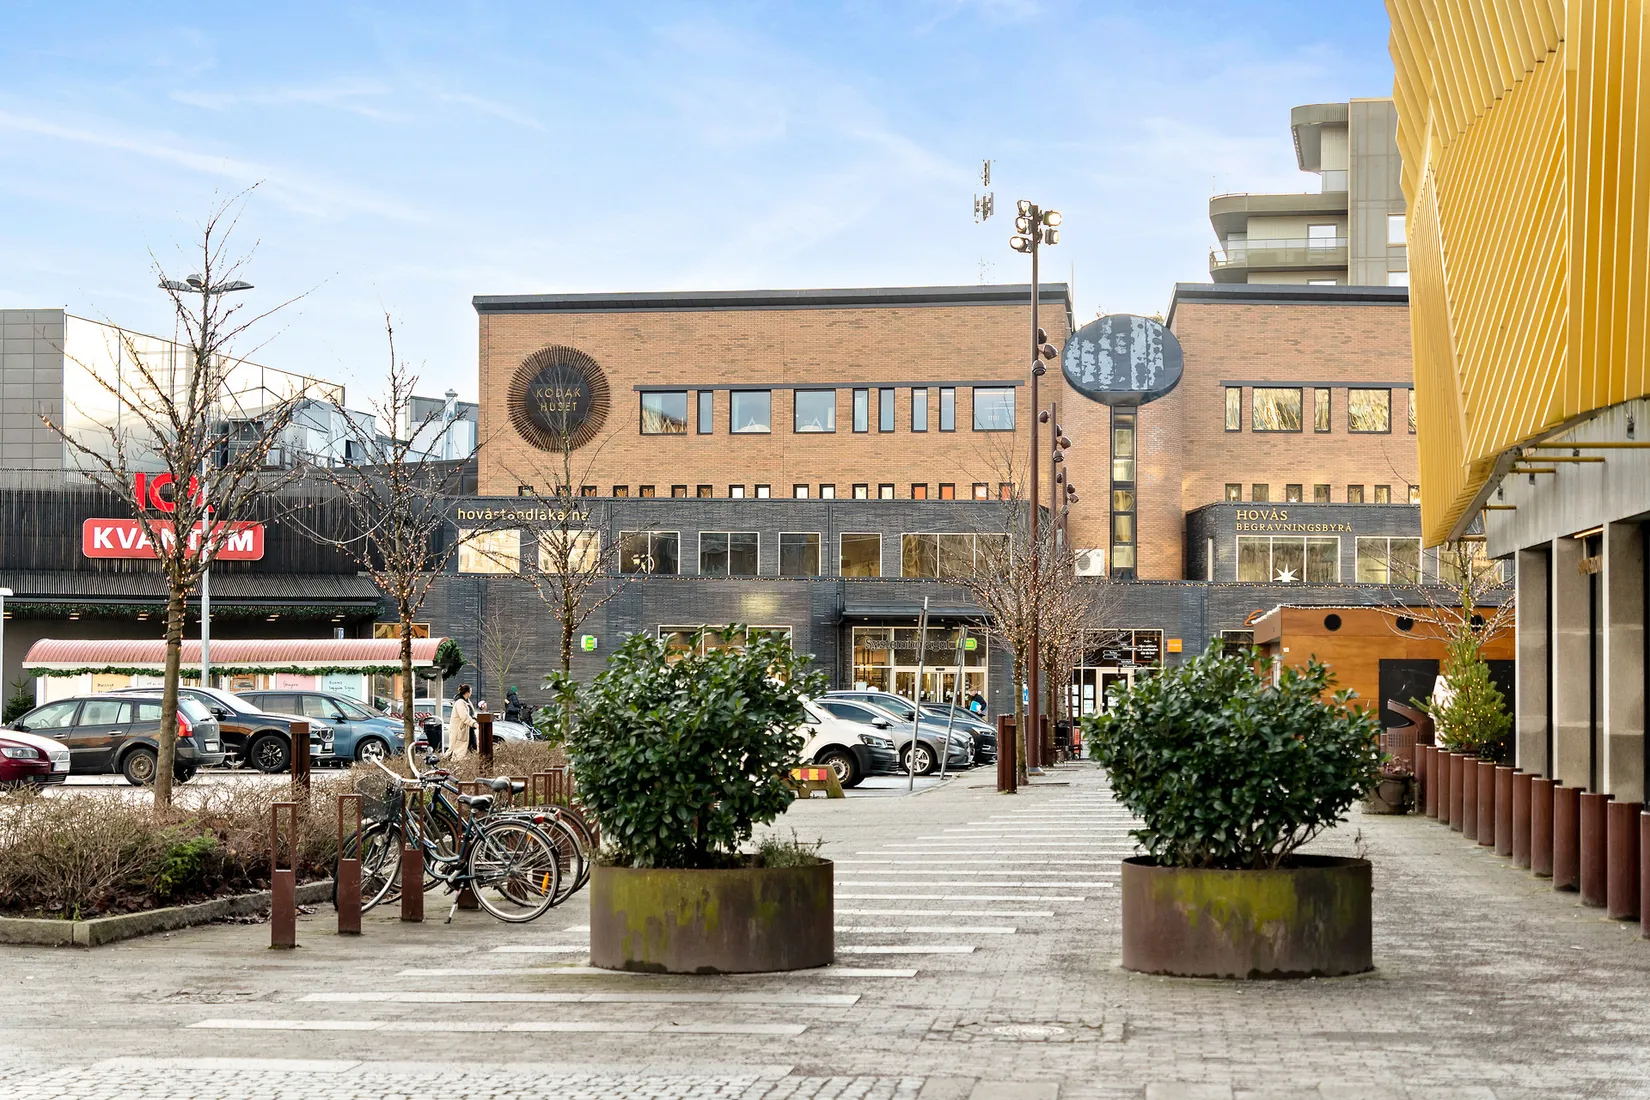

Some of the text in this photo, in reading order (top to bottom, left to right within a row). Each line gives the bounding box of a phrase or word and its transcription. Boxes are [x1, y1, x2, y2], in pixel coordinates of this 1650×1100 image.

[536, 387, 581, 398] KODAK
[540, 402, 577, 412] HUSET
[457, 508, 589, 520] hovåstandläkana
[1236, 508, 1288, 520] HOVÅS
[1236, 522, 1352, 532] BEGRAVNINGSBYRÅ
[865, 637, 950, 652] Systemboaget
